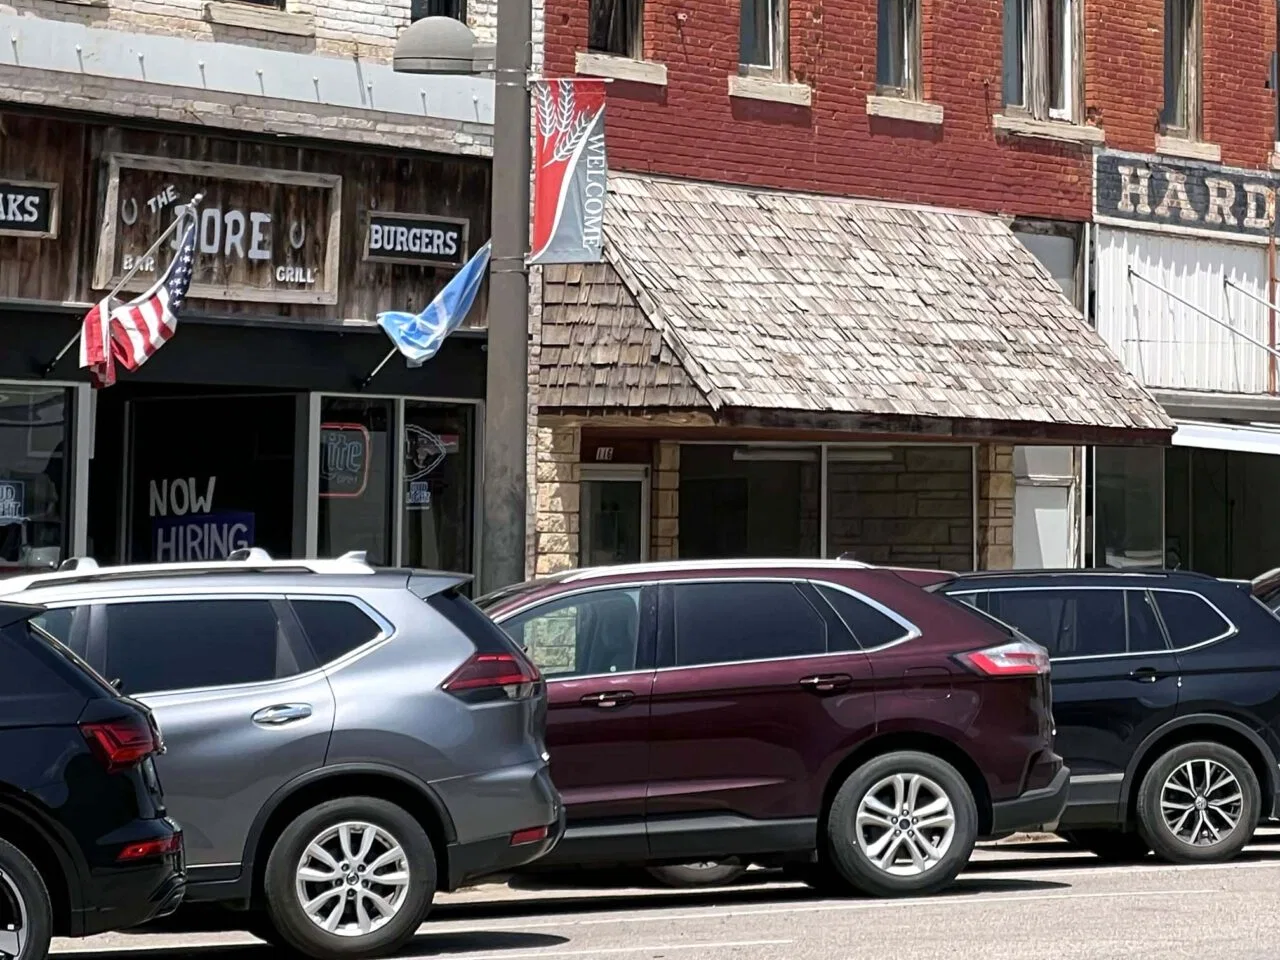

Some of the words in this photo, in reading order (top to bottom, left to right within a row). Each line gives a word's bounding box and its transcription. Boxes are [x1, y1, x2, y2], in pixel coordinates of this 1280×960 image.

[147, 184, 178, 214] THE
[583, 134, 605, 249] WELCOME
[369, 224, 458, 255] BURGERS
[122, 253, 155, 272] BAR
[275, 265, 316, 283] GRILL
[149, 475, 216, 517] NOW
[157, 523, 248, 562] HIRING
